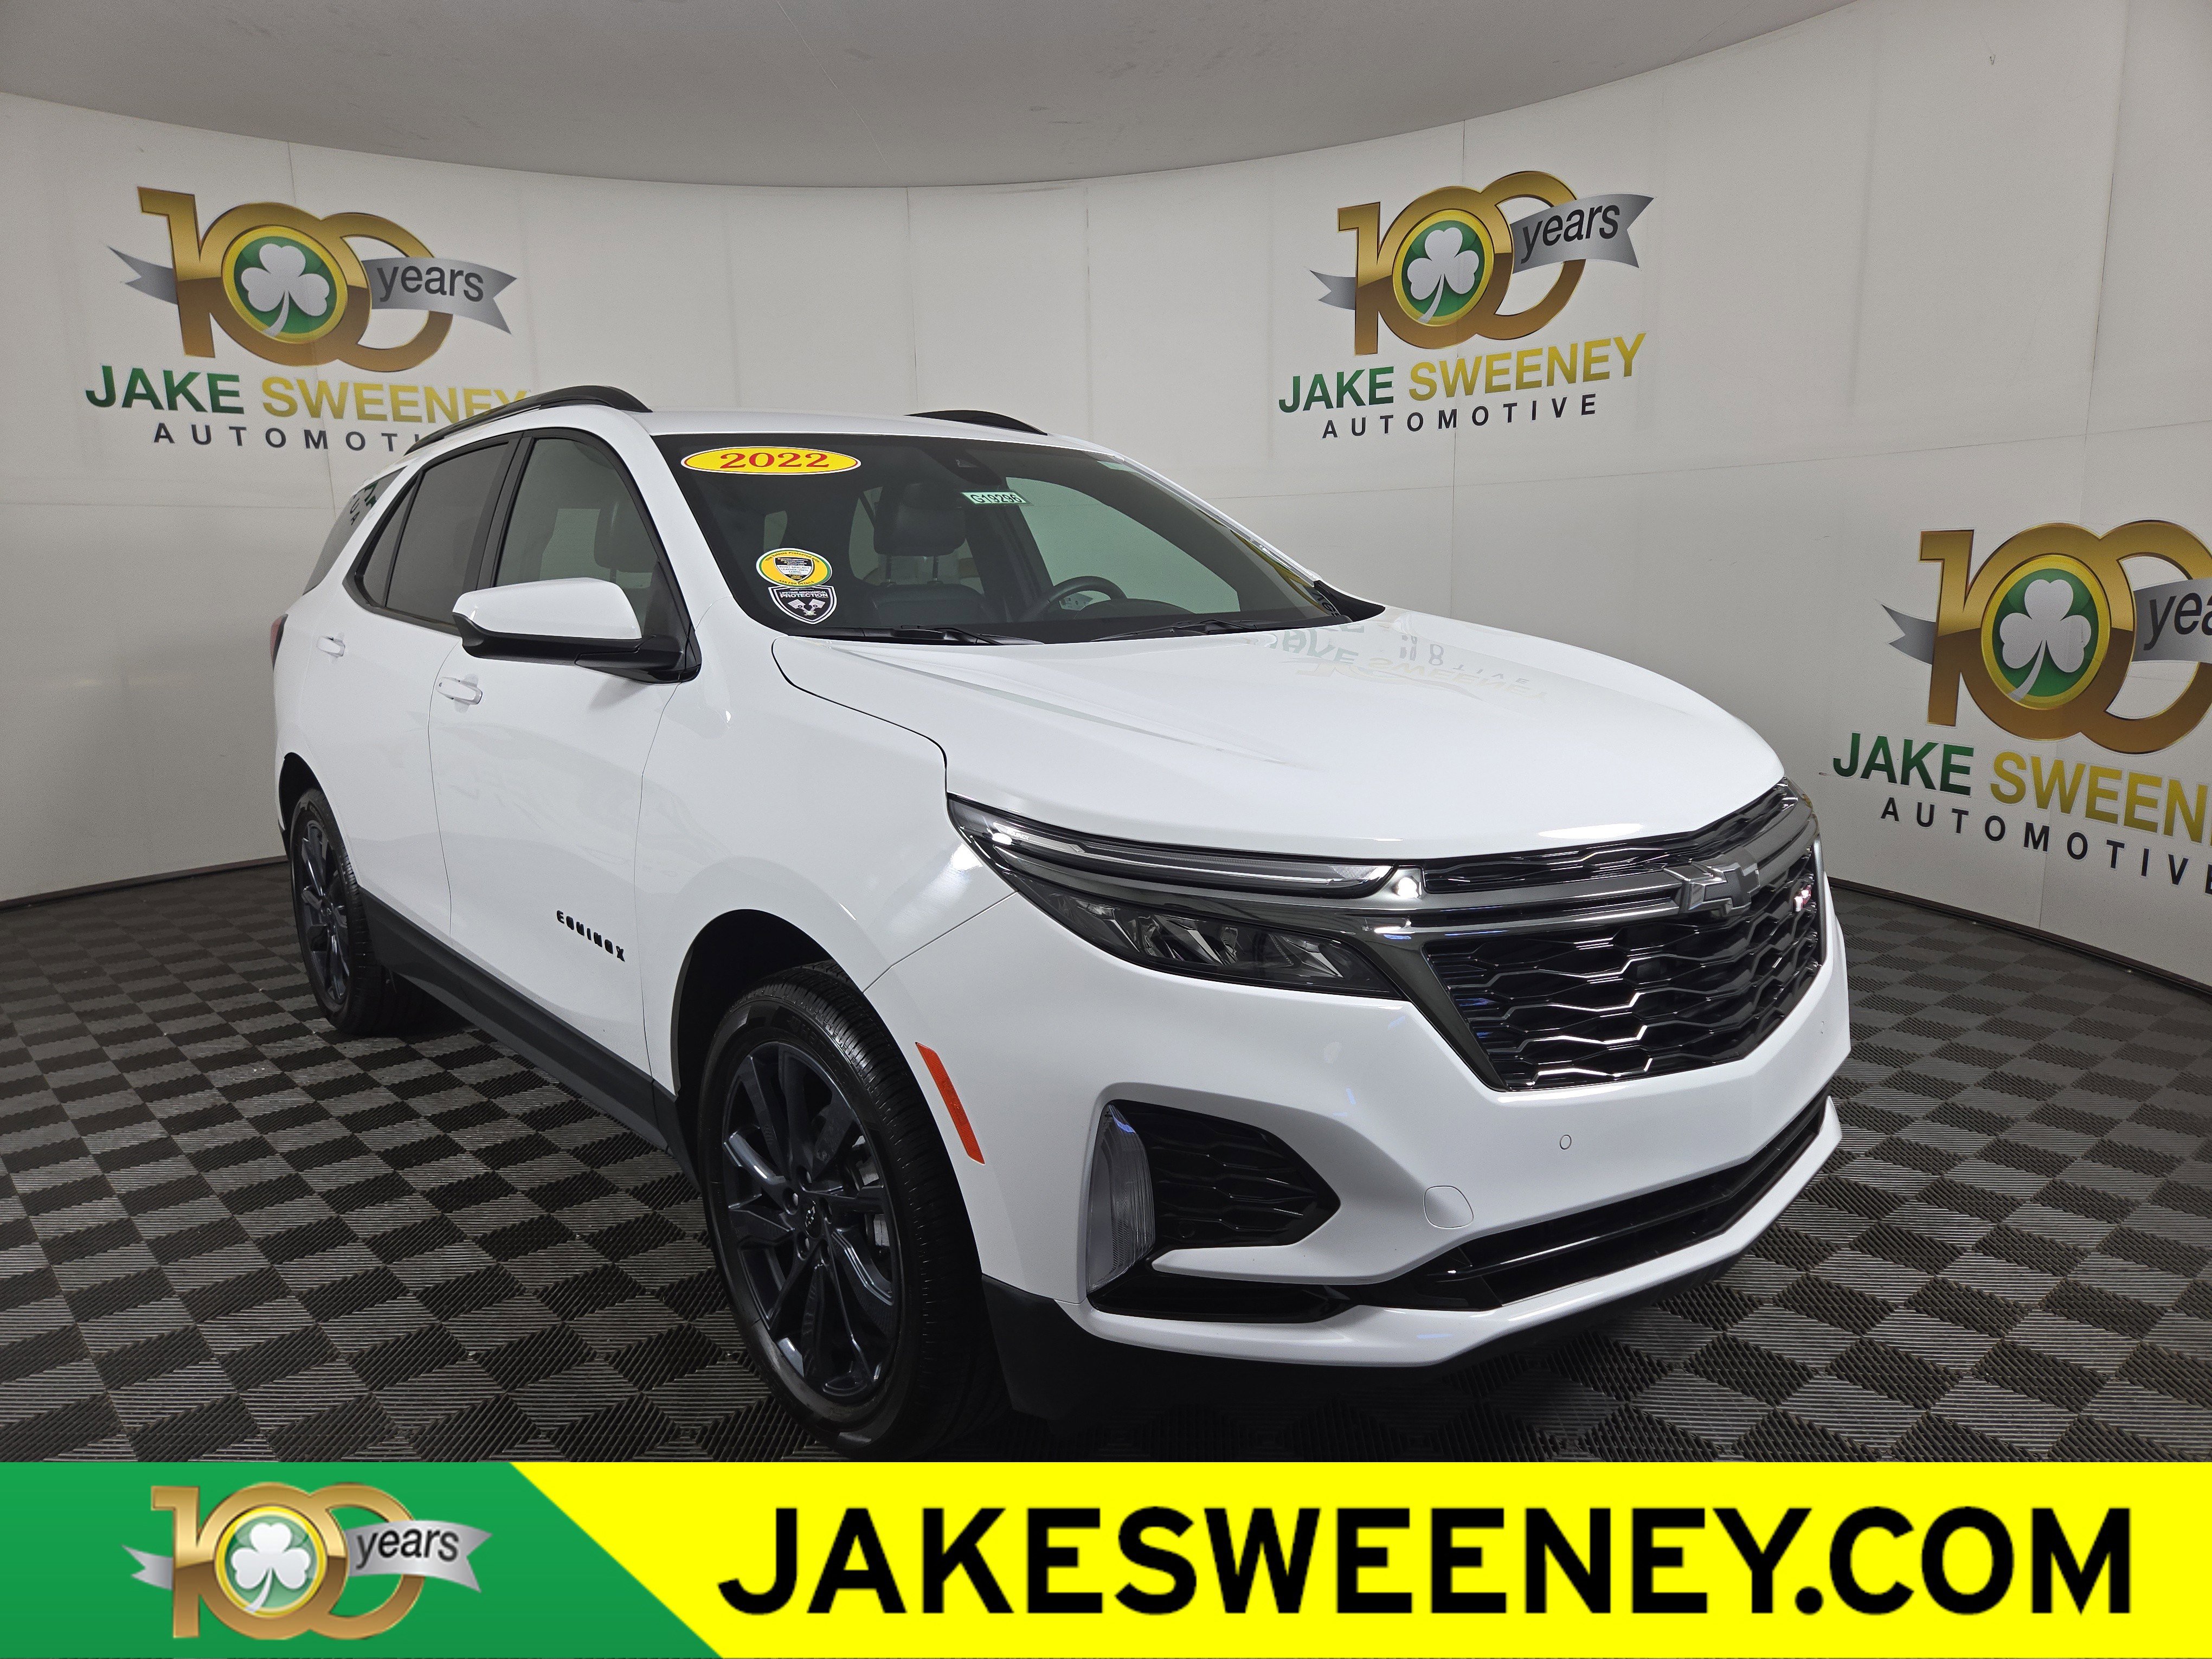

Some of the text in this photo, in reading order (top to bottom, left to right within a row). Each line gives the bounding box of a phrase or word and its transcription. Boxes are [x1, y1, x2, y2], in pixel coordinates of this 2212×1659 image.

[1520, 204, 1621, 265] years
[377, 266, 484, 303] years
[85, 365, 245, 414] JAKE
[1279, 332, 1647, 413] JAKE SWEENEY
[153, 422, 419, 452] AUTOMOT
[1322, 393, 1596, 439] AUTOMOTIVE
[720, 453, 829, 468] 2022
[970, 494, 1023, 503] G19296
[1833, 732, 2212, 847] JAKE SWEEN
[556, 910, 626, 962] EQUINOX
